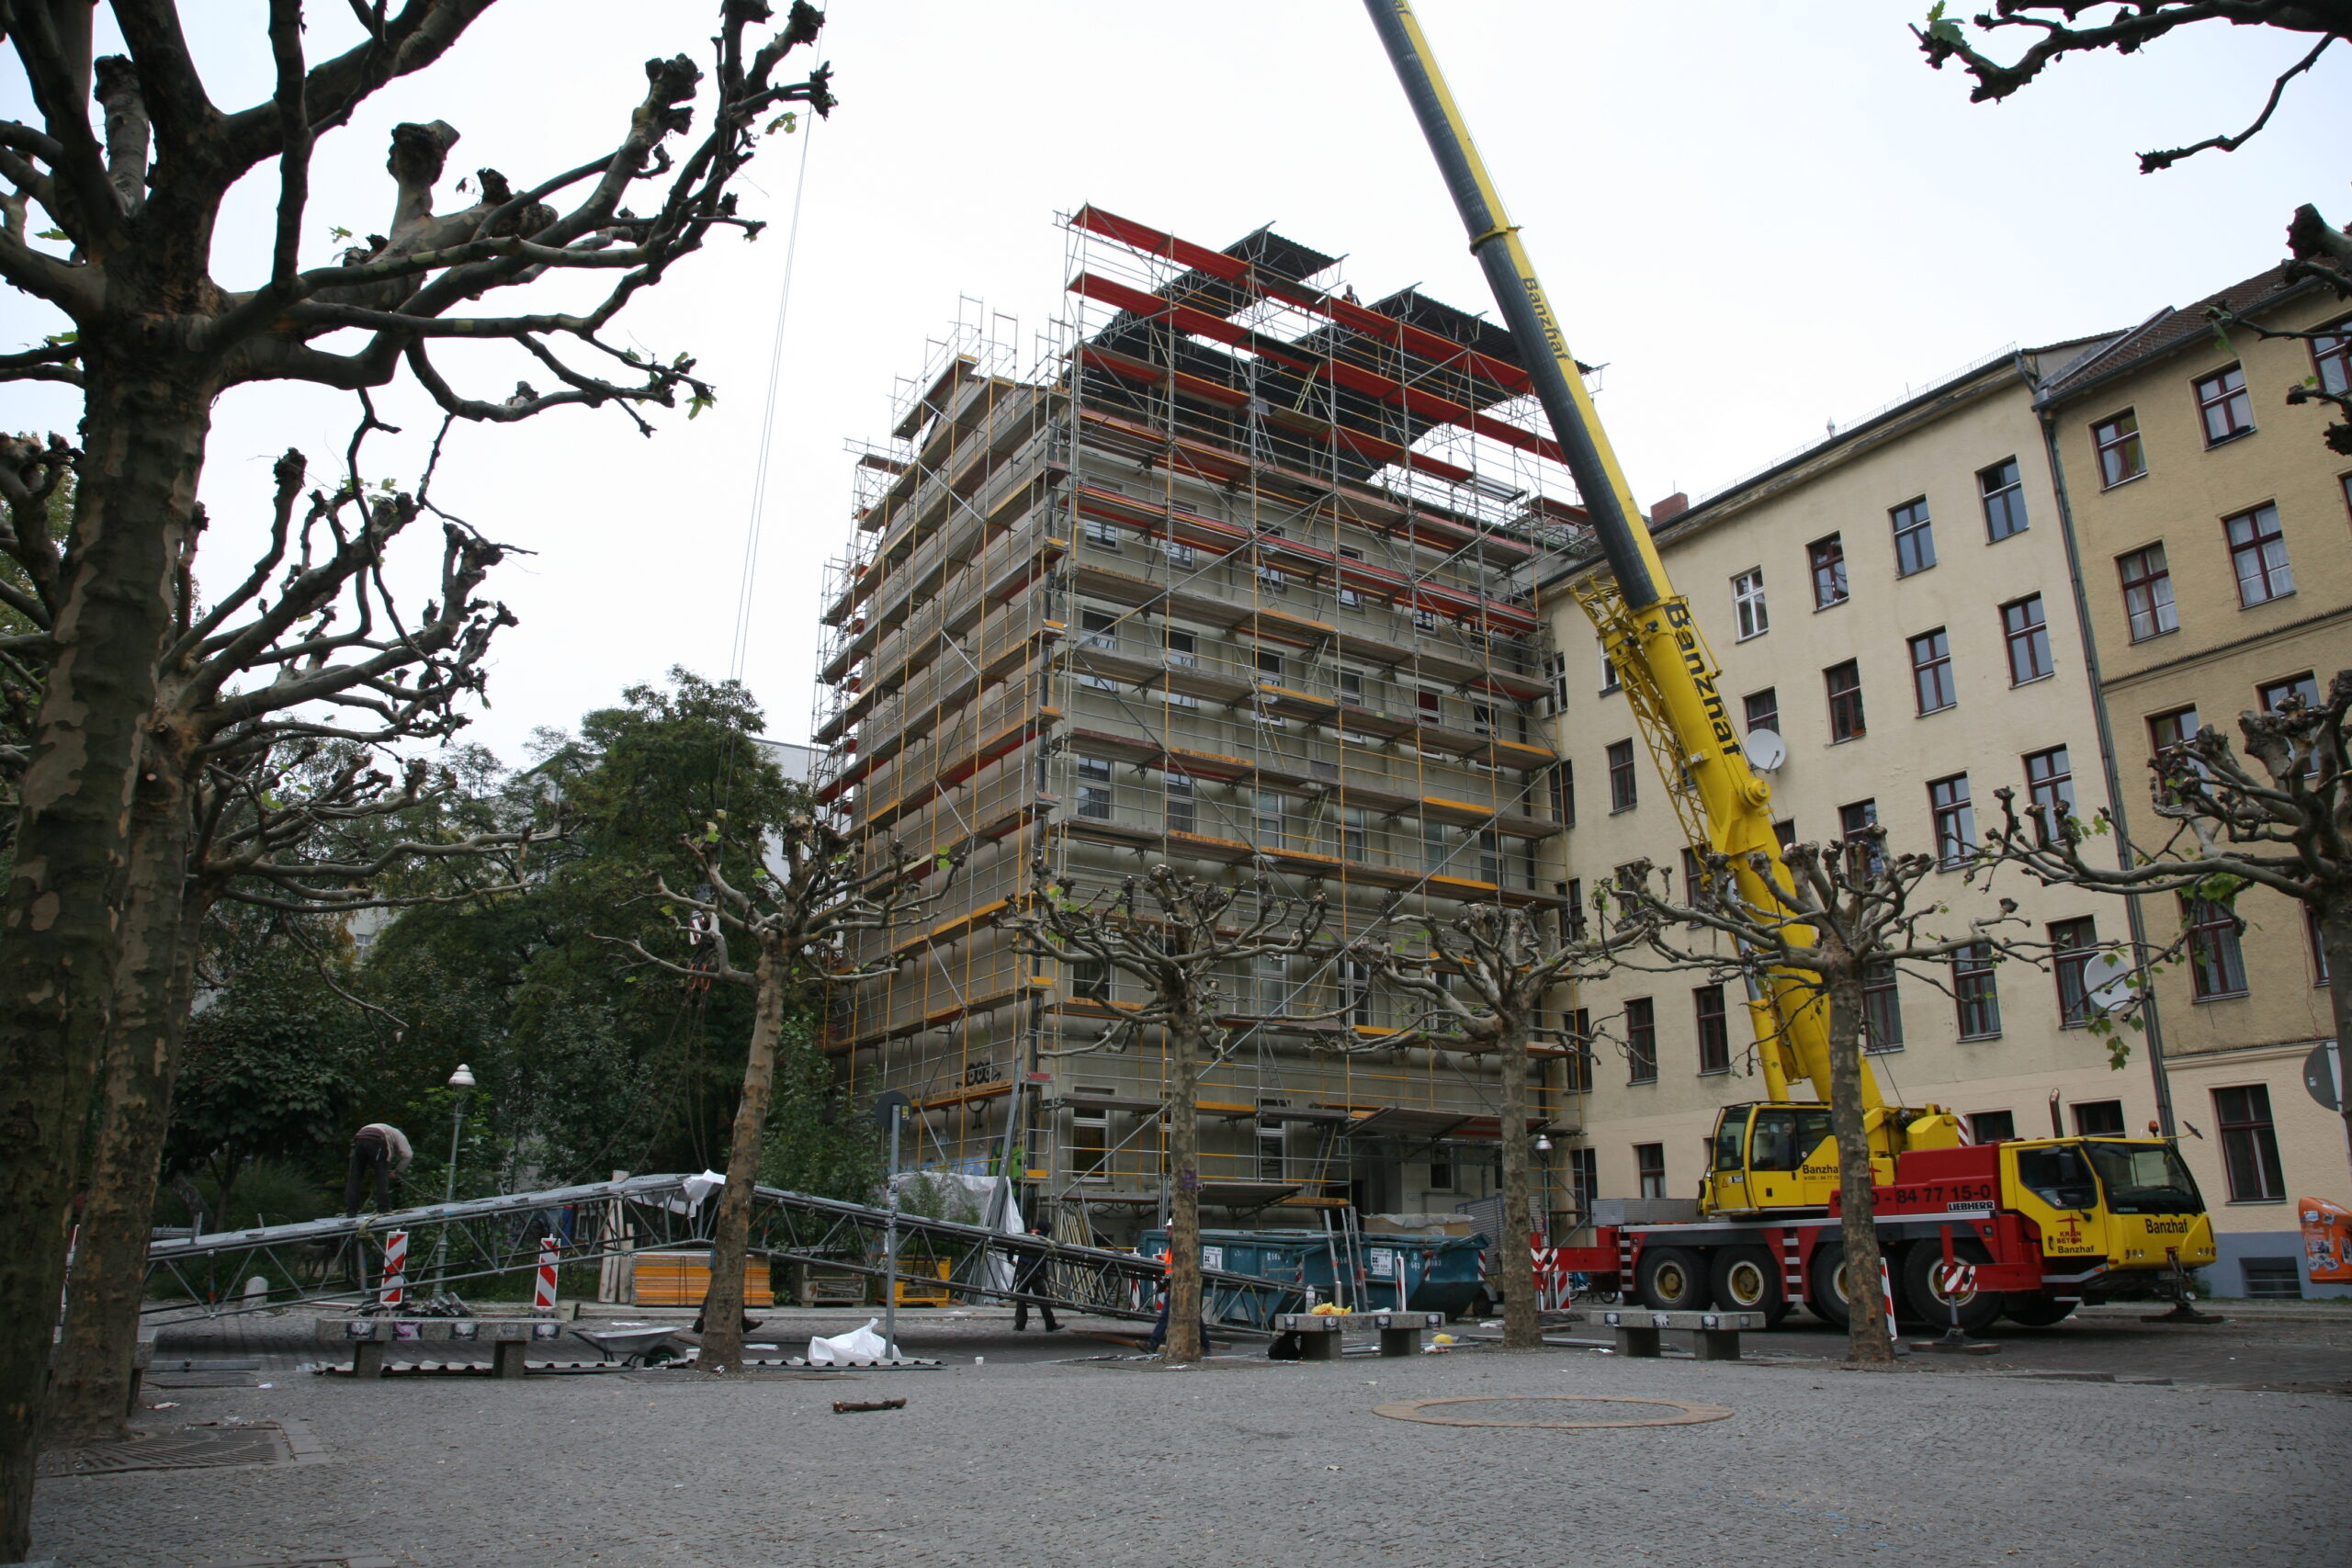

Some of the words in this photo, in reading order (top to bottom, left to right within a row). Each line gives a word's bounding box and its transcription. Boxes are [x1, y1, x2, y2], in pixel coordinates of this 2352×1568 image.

[1522, 277, 1570, 360] Banzhaf
[1664, 603, 1741, 756] Banzhaf
[1803, 1164, 1840, 1174] Banzha
[1896, 1190, 1918, 1204] 84
[1923, 1187, 1944, 1201] 77
[1951, 1184, 1992, 1201] 15-0
[1948, 1201, 1995, 1212] LIEBHERR
[2145, 1218, 2188, 1234] Banzhaf
[2058, 1245, 2094, 1254] Banzhaf
